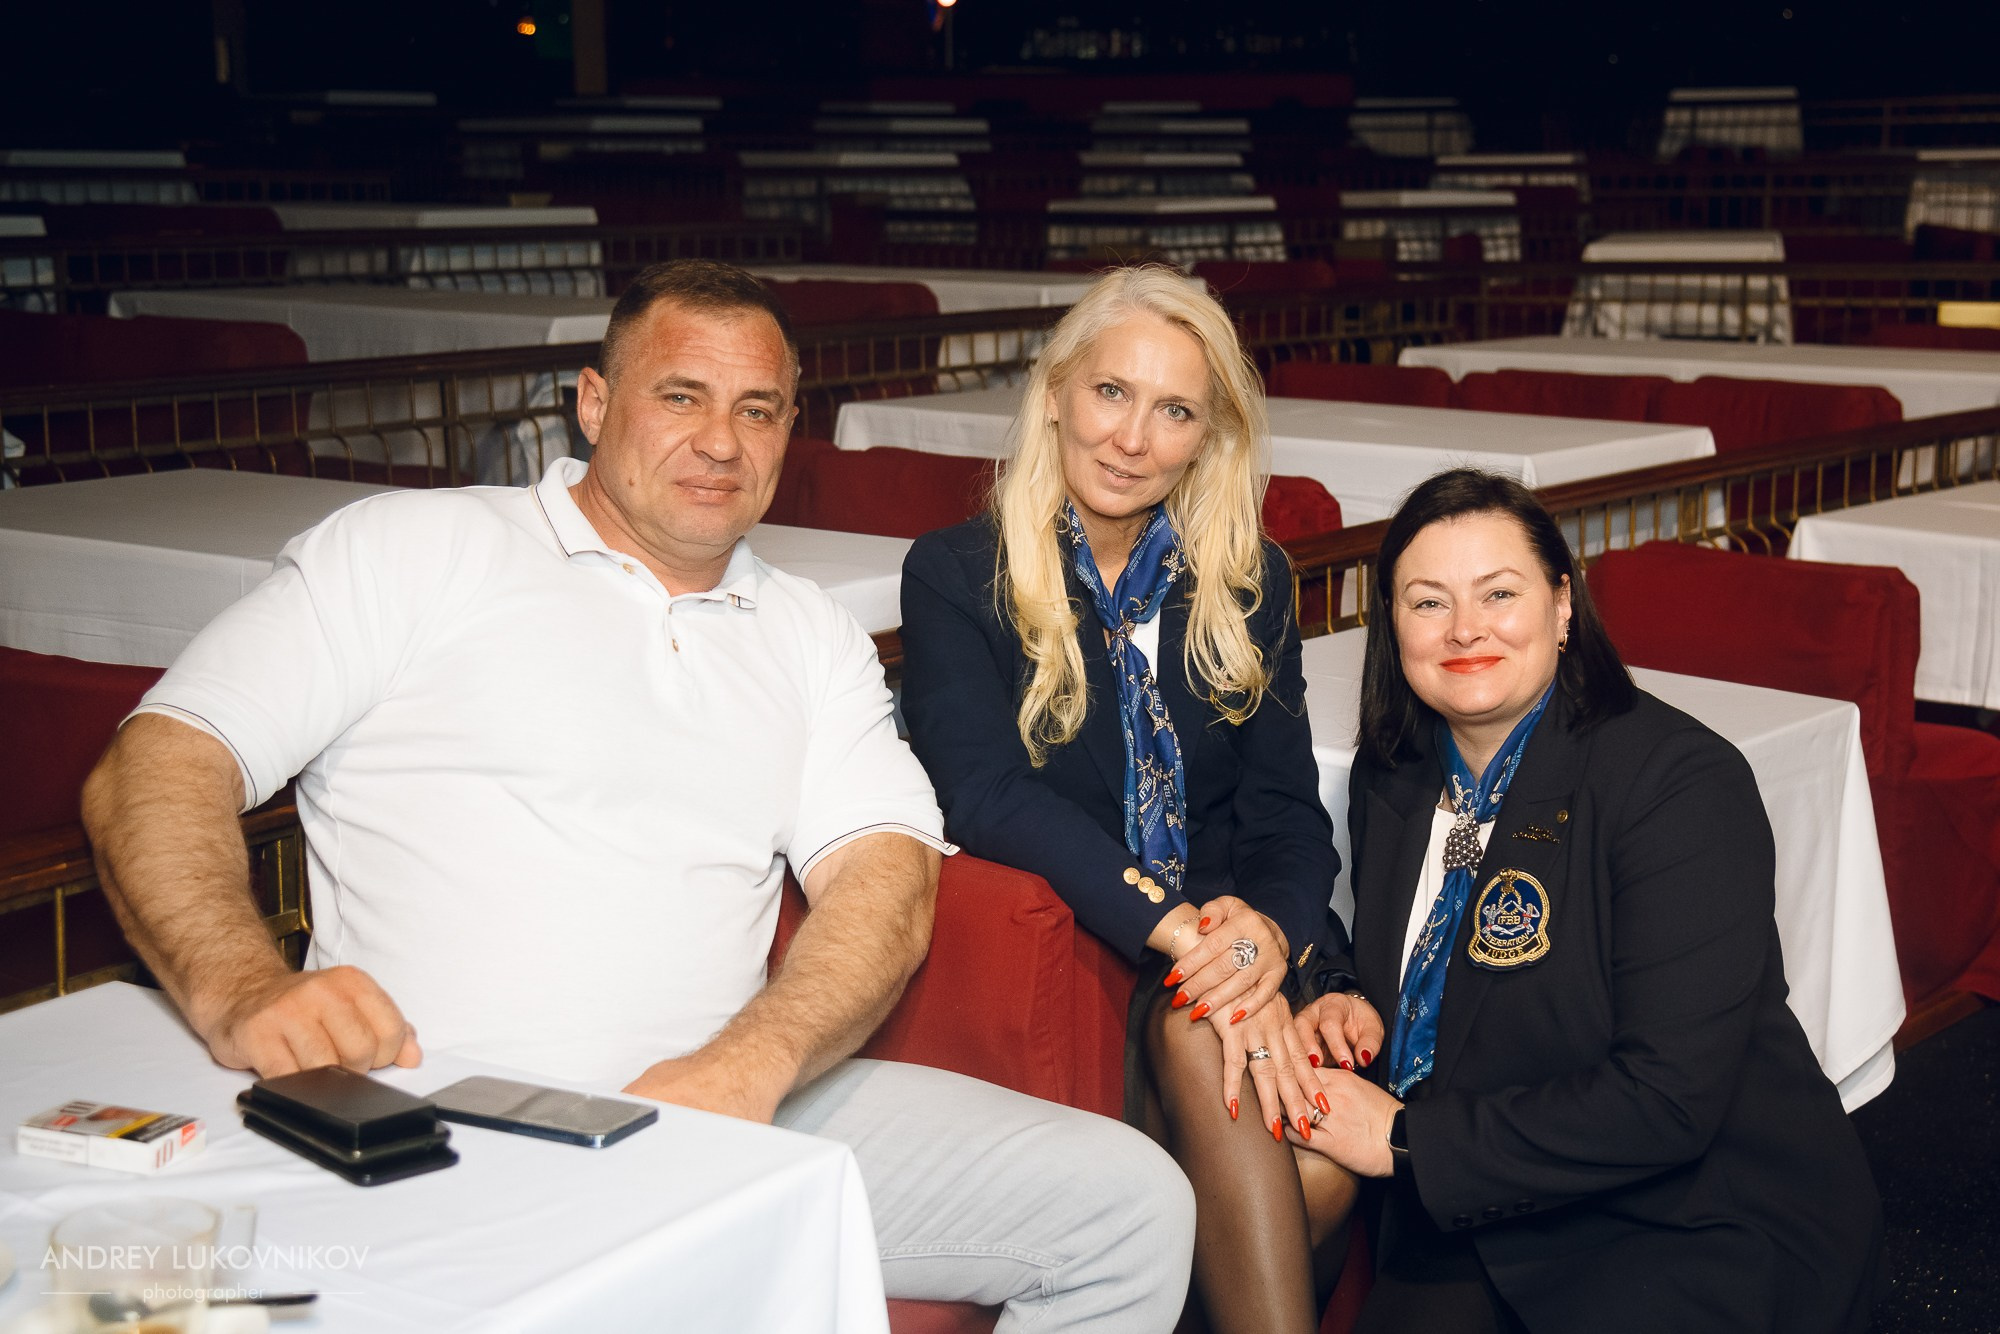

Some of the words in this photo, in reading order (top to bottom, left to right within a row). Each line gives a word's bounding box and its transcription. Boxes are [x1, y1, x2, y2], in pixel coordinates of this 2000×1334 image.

[1138, 776, 1153, 801] IFBB
[1163, 784, 1175, 807] IFBB
[1497, 915, 1522, 925] IFBB
[1485, 932, 1530, 947] FEDERATION
[1485, 947, 1525, 959] JUDGE
